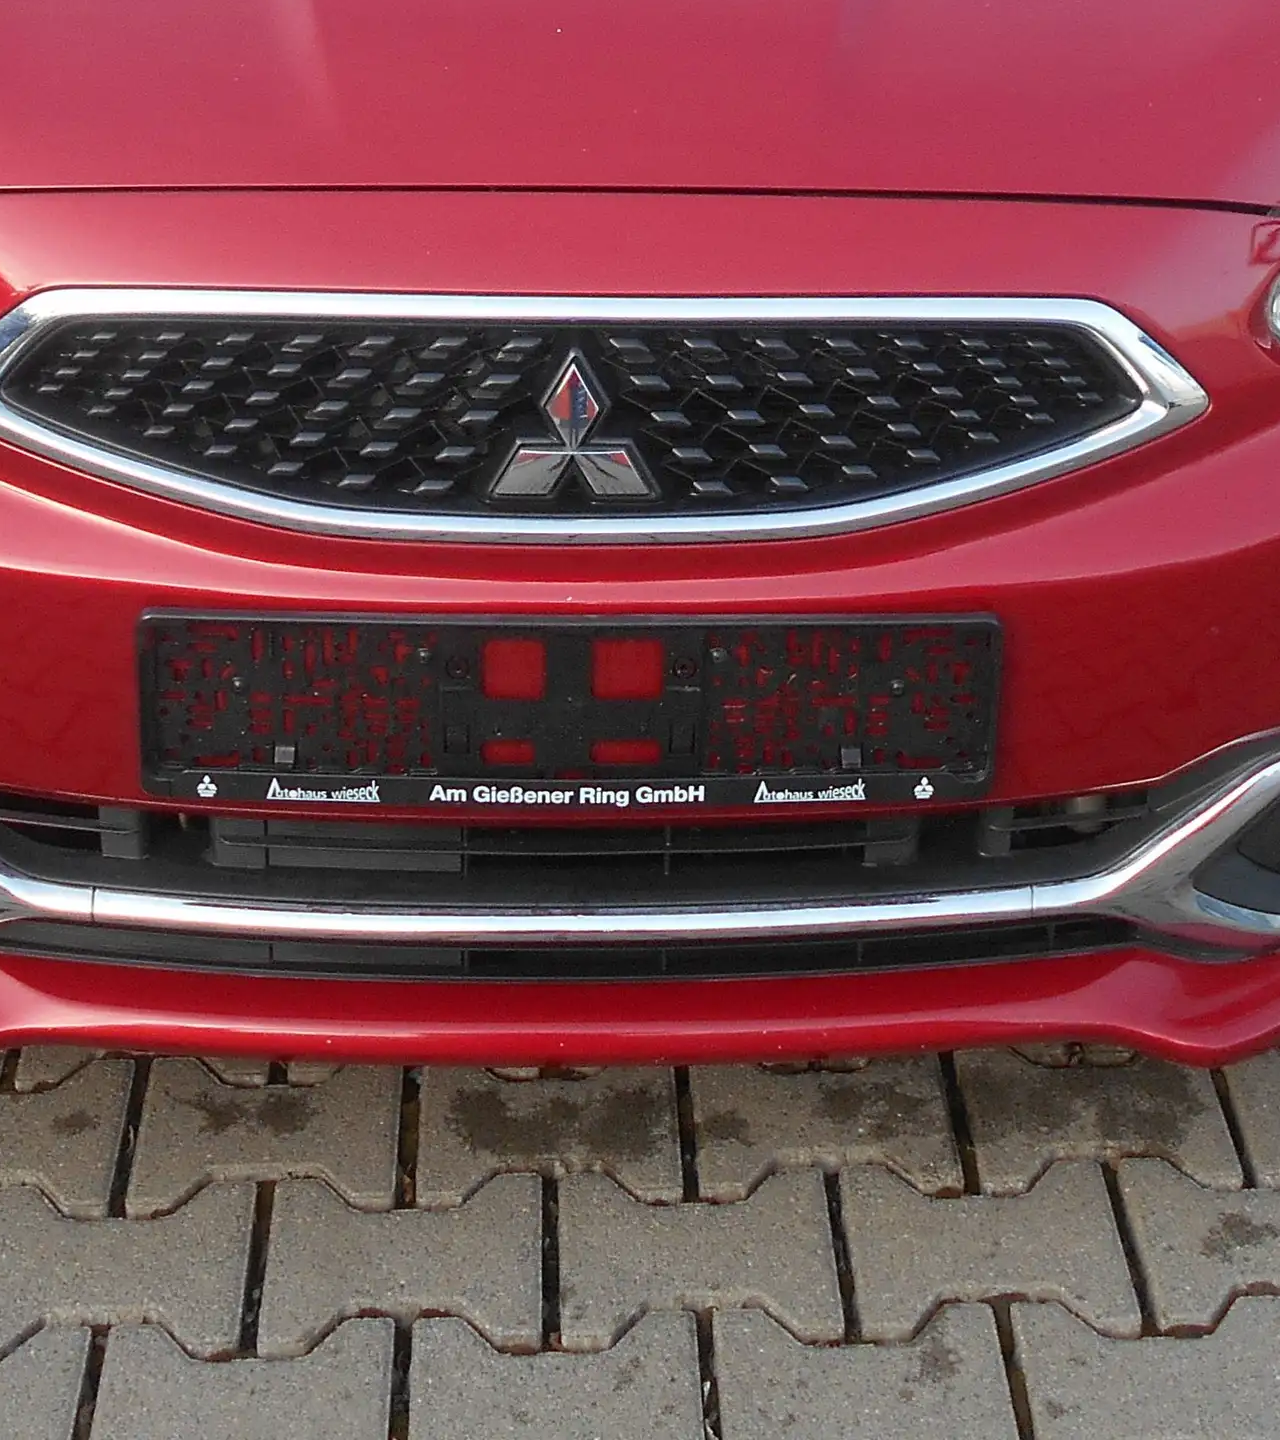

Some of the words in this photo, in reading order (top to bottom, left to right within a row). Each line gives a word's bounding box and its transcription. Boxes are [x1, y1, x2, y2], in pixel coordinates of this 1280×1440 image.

[331, 779, 380, 801] wieseck
[429, 784, 467, 802] Am
[473, 785, 574, 805] Gießener
[579, 786, 630, 807] Ring
[635, 785, 706, 804] GmbH
[817, 777, 866, 801] wieseck
